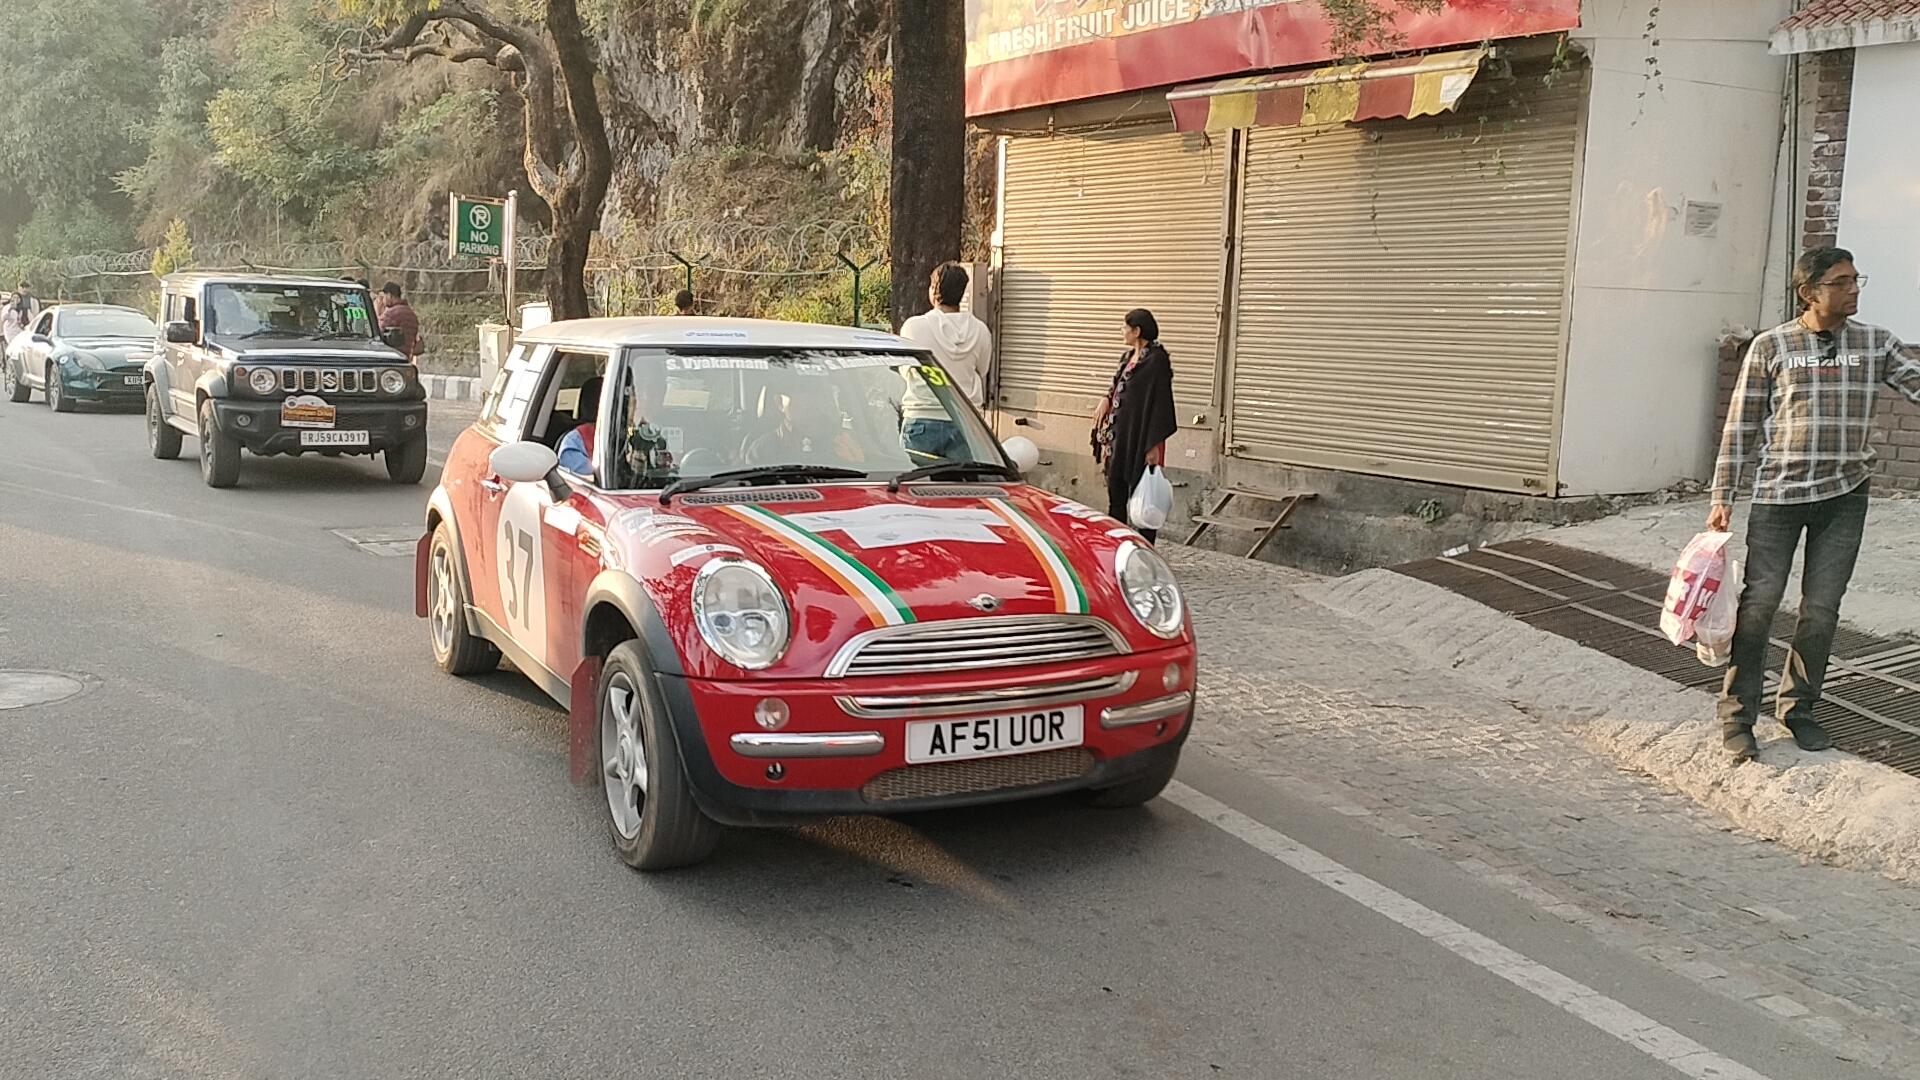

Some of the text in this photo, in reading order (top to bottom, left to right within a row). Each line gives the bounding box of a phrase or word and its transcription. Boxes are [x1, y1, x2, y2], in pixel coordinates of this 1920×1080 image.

[988, 21, 1048, 56] FRESH
[1054, 8, 1117, 43] FRUIT
[1123, 0, 1191, 30] JUICE
[470, 230, 489, 243] NO
[459, 241, 500, 256] PARKING
[665, 357, 681, 371] S.
[1788, 354, 1861, 369] INSANE
[308, 432, 367, 443] RJ59CA3917
[504, 520, 534, 632] 37
